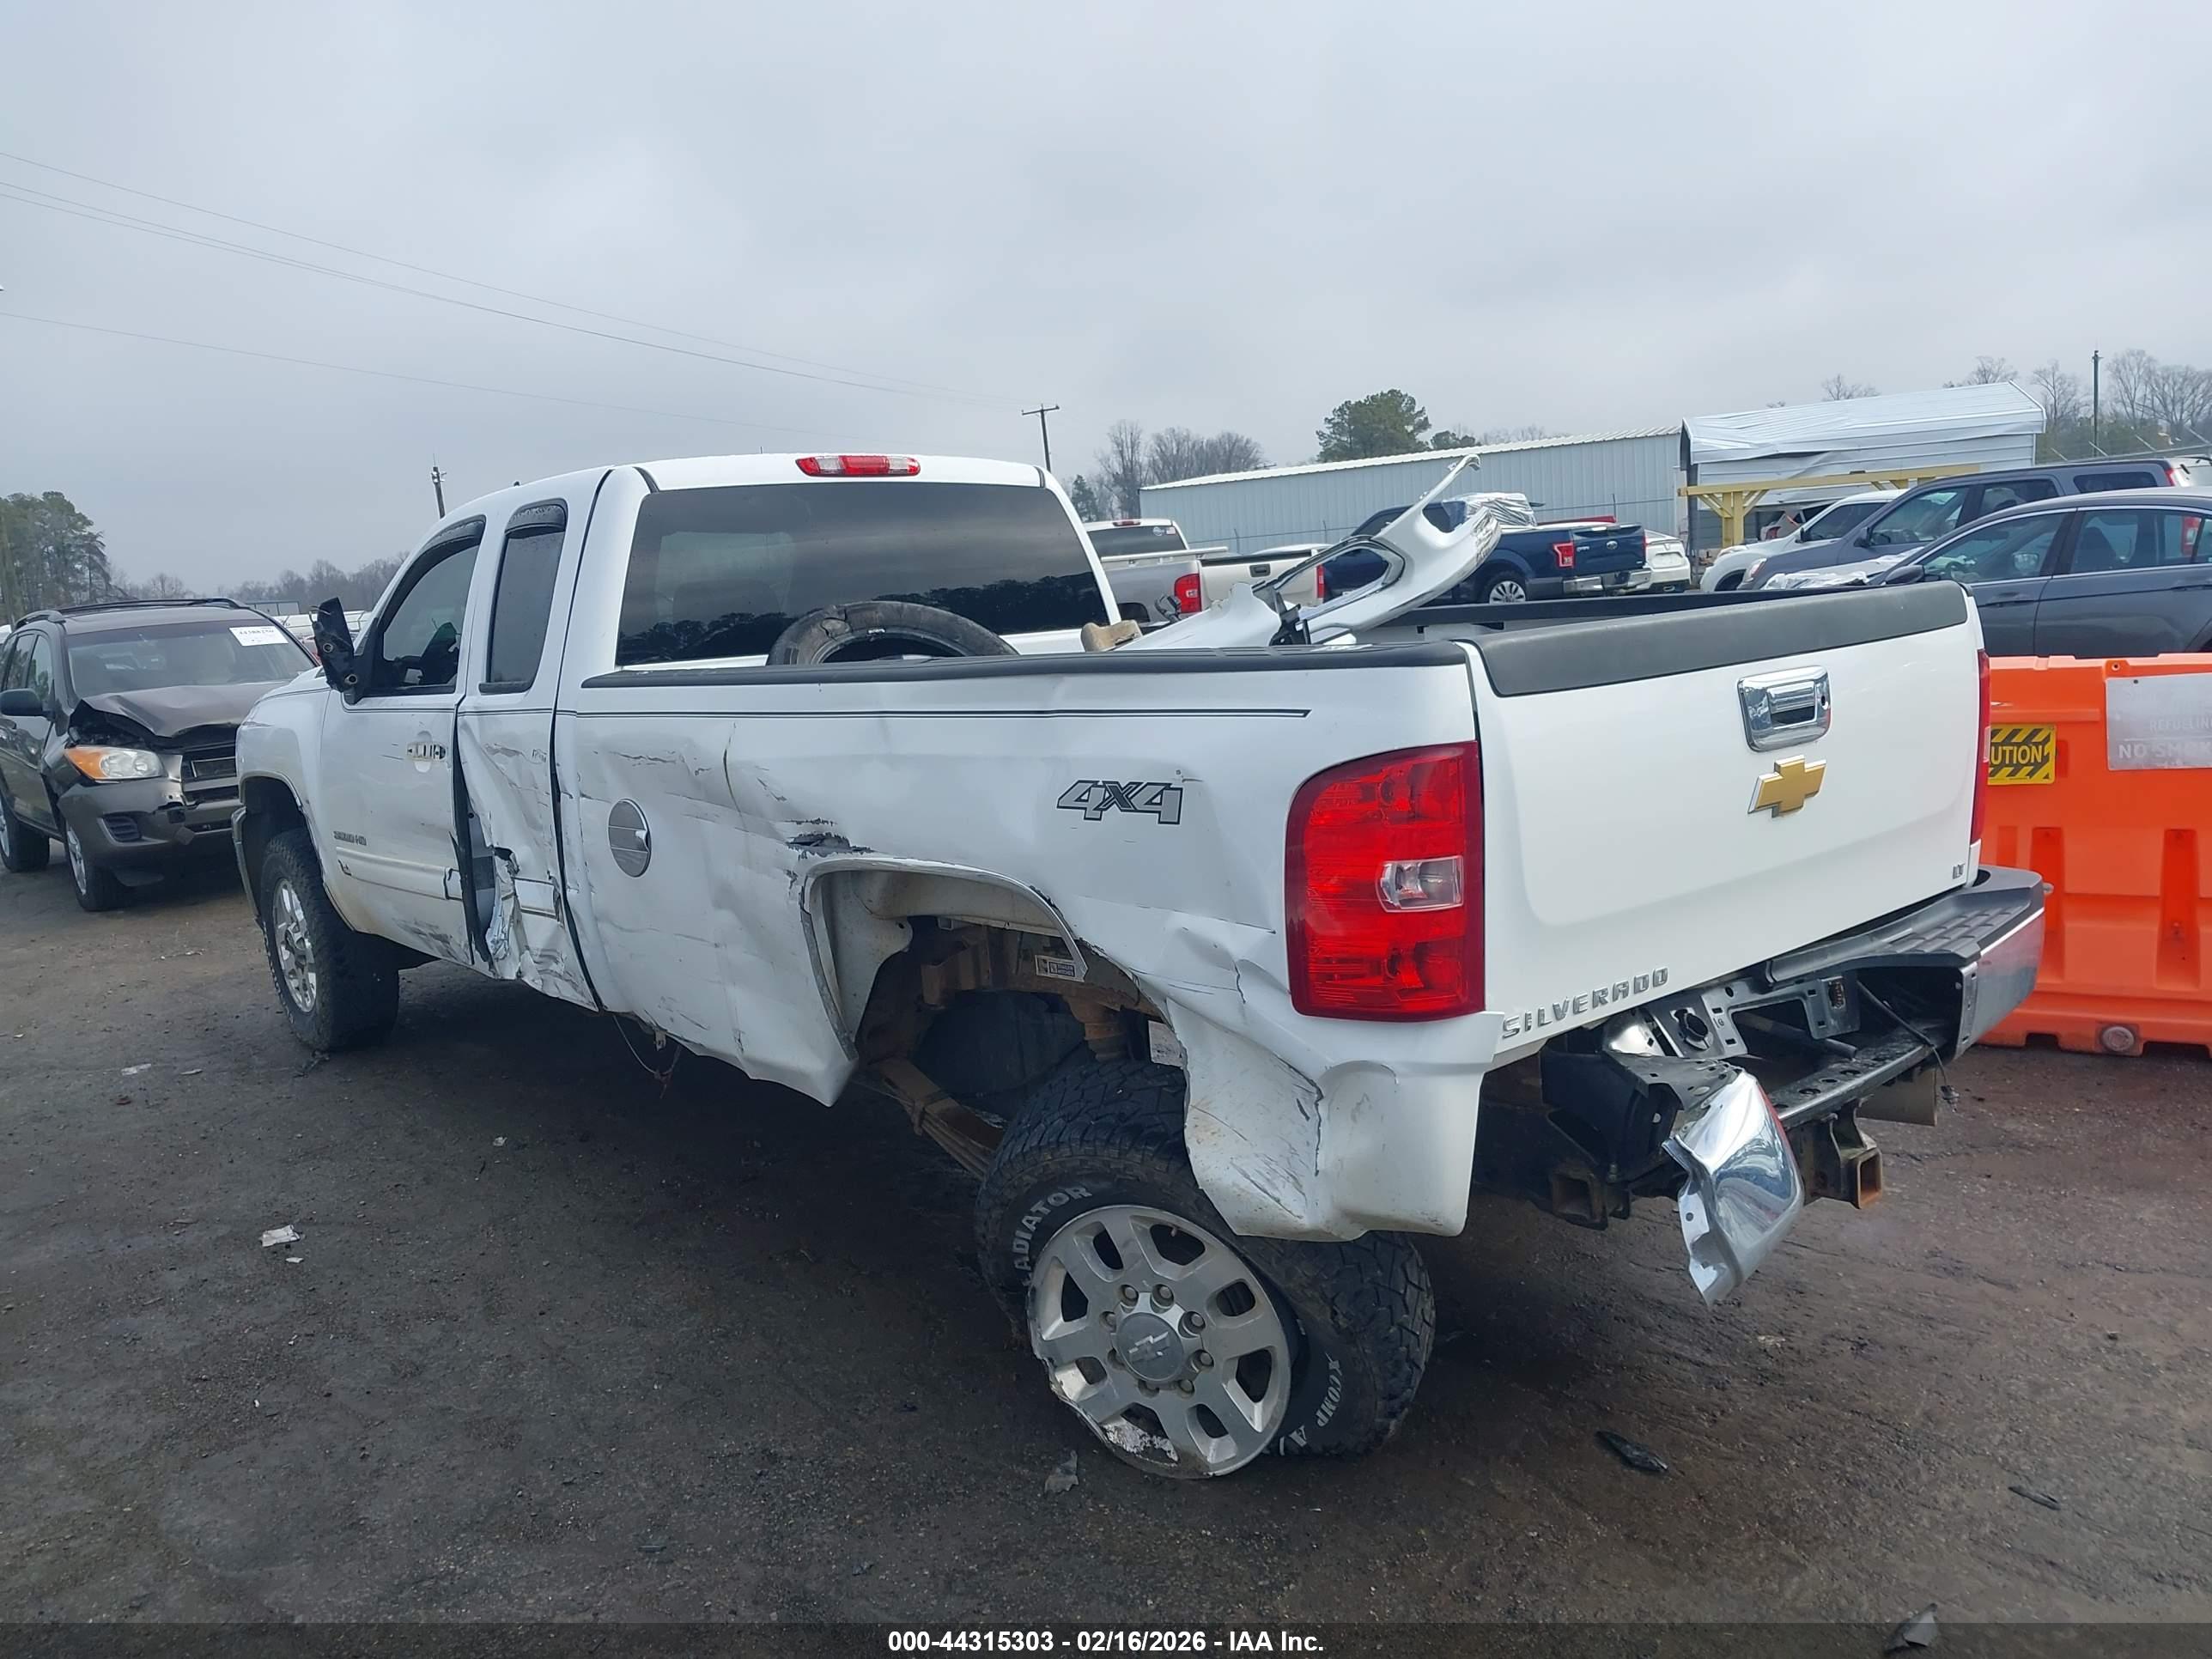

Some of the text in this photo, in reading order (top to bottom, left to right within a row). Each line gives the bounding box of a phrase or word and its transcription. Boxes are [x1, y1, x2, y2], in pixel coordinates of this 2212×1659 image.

[1990, 744, 2043, 764] UTION
[2118, 740, 2212, 759] NO SMOK
[1502, 967, 1668, 1039] SILVERADO
[1012, 1187, 1093, 1273] ADIATOR
